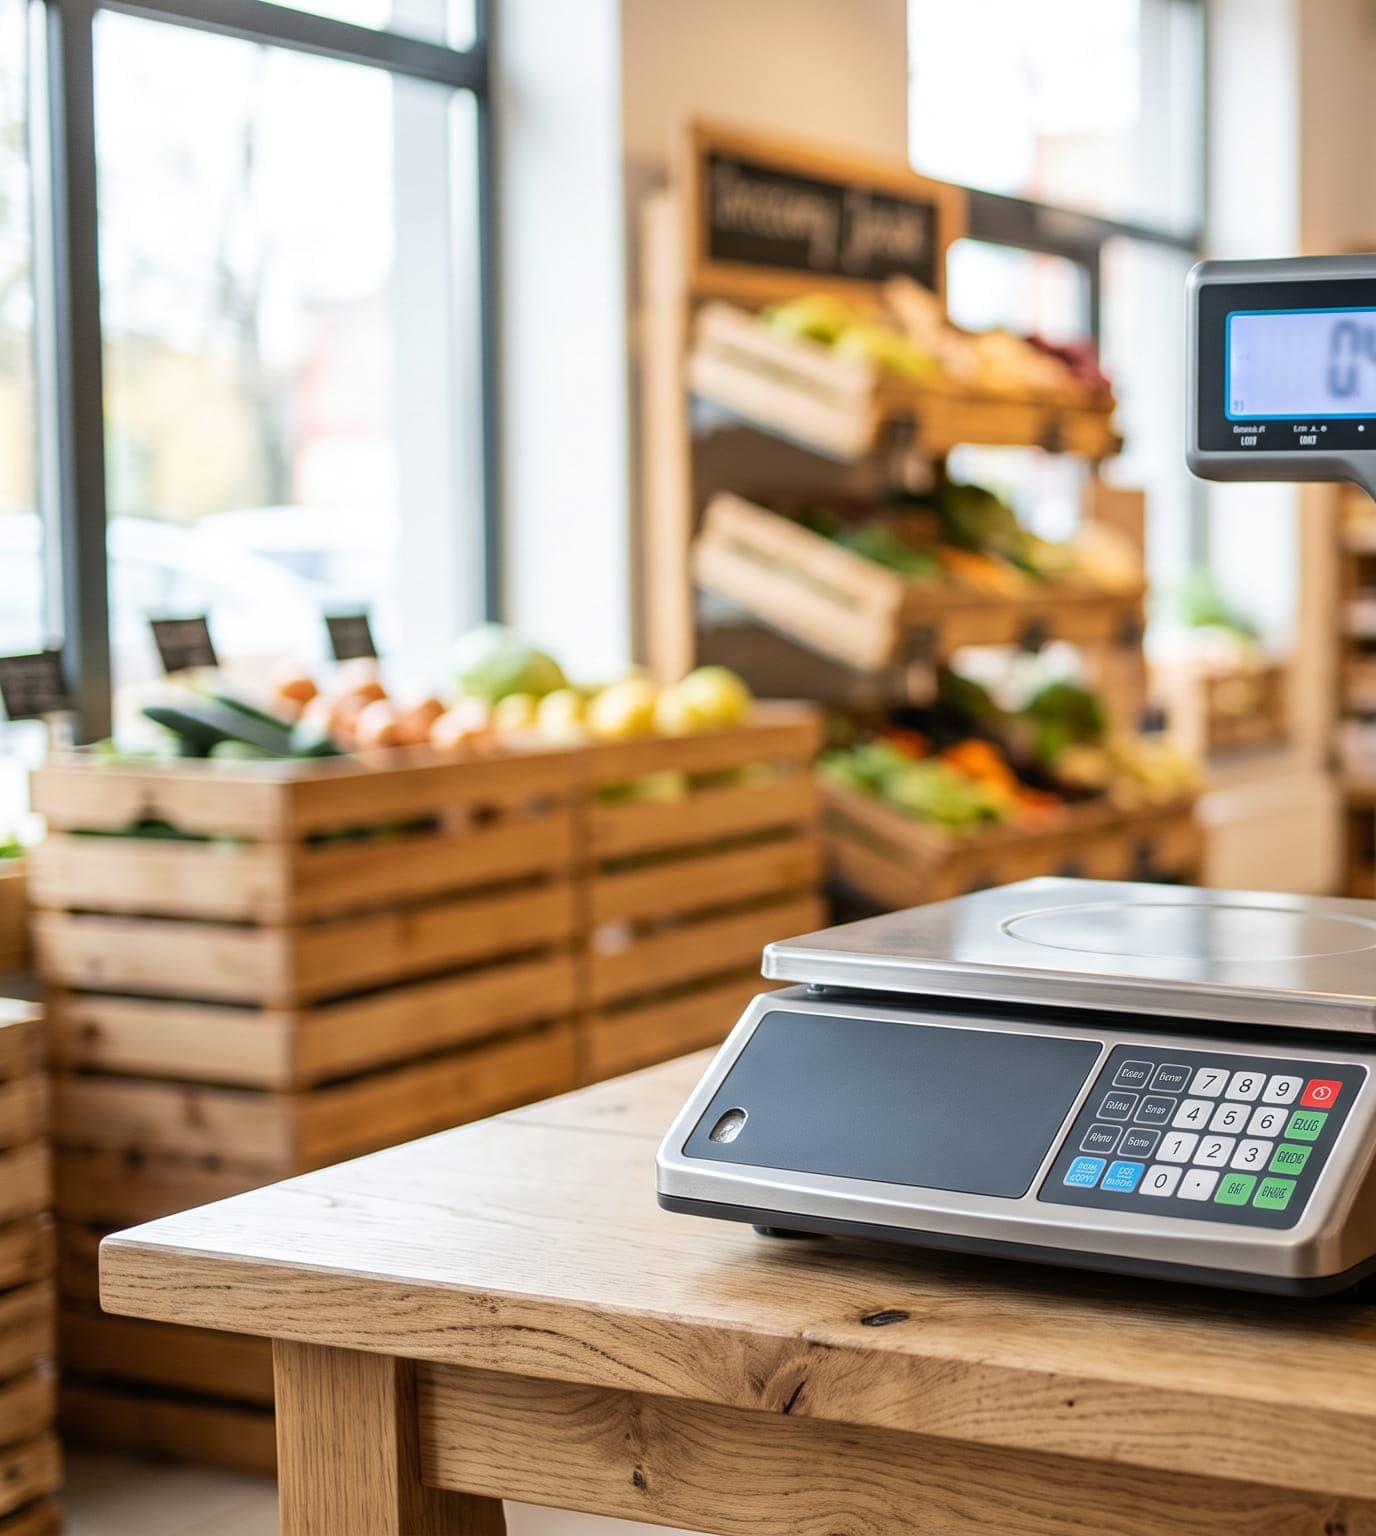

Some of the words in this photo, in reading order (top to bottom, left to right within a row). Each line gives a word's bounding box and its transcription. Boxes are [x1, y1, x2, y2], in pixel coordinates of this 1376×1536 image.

[1202, 1074, 1218, 1090] 7
[1238, 1078, 1253, 1093] 8
[1275, 1081, 1290, 1097] 9
[1186, 1107, 1200, 1122] 4
[1223, 1110, 1238, 1125] 5
[1260, 1114, 1275, 1129] 6
[1173, 1140, 1183, 1155] 1
[1206, 1143, 1222, 1159] 2
[1244, 1147, 1259, 1162] 3
[1154, 1173, 1168, 1189] 0
